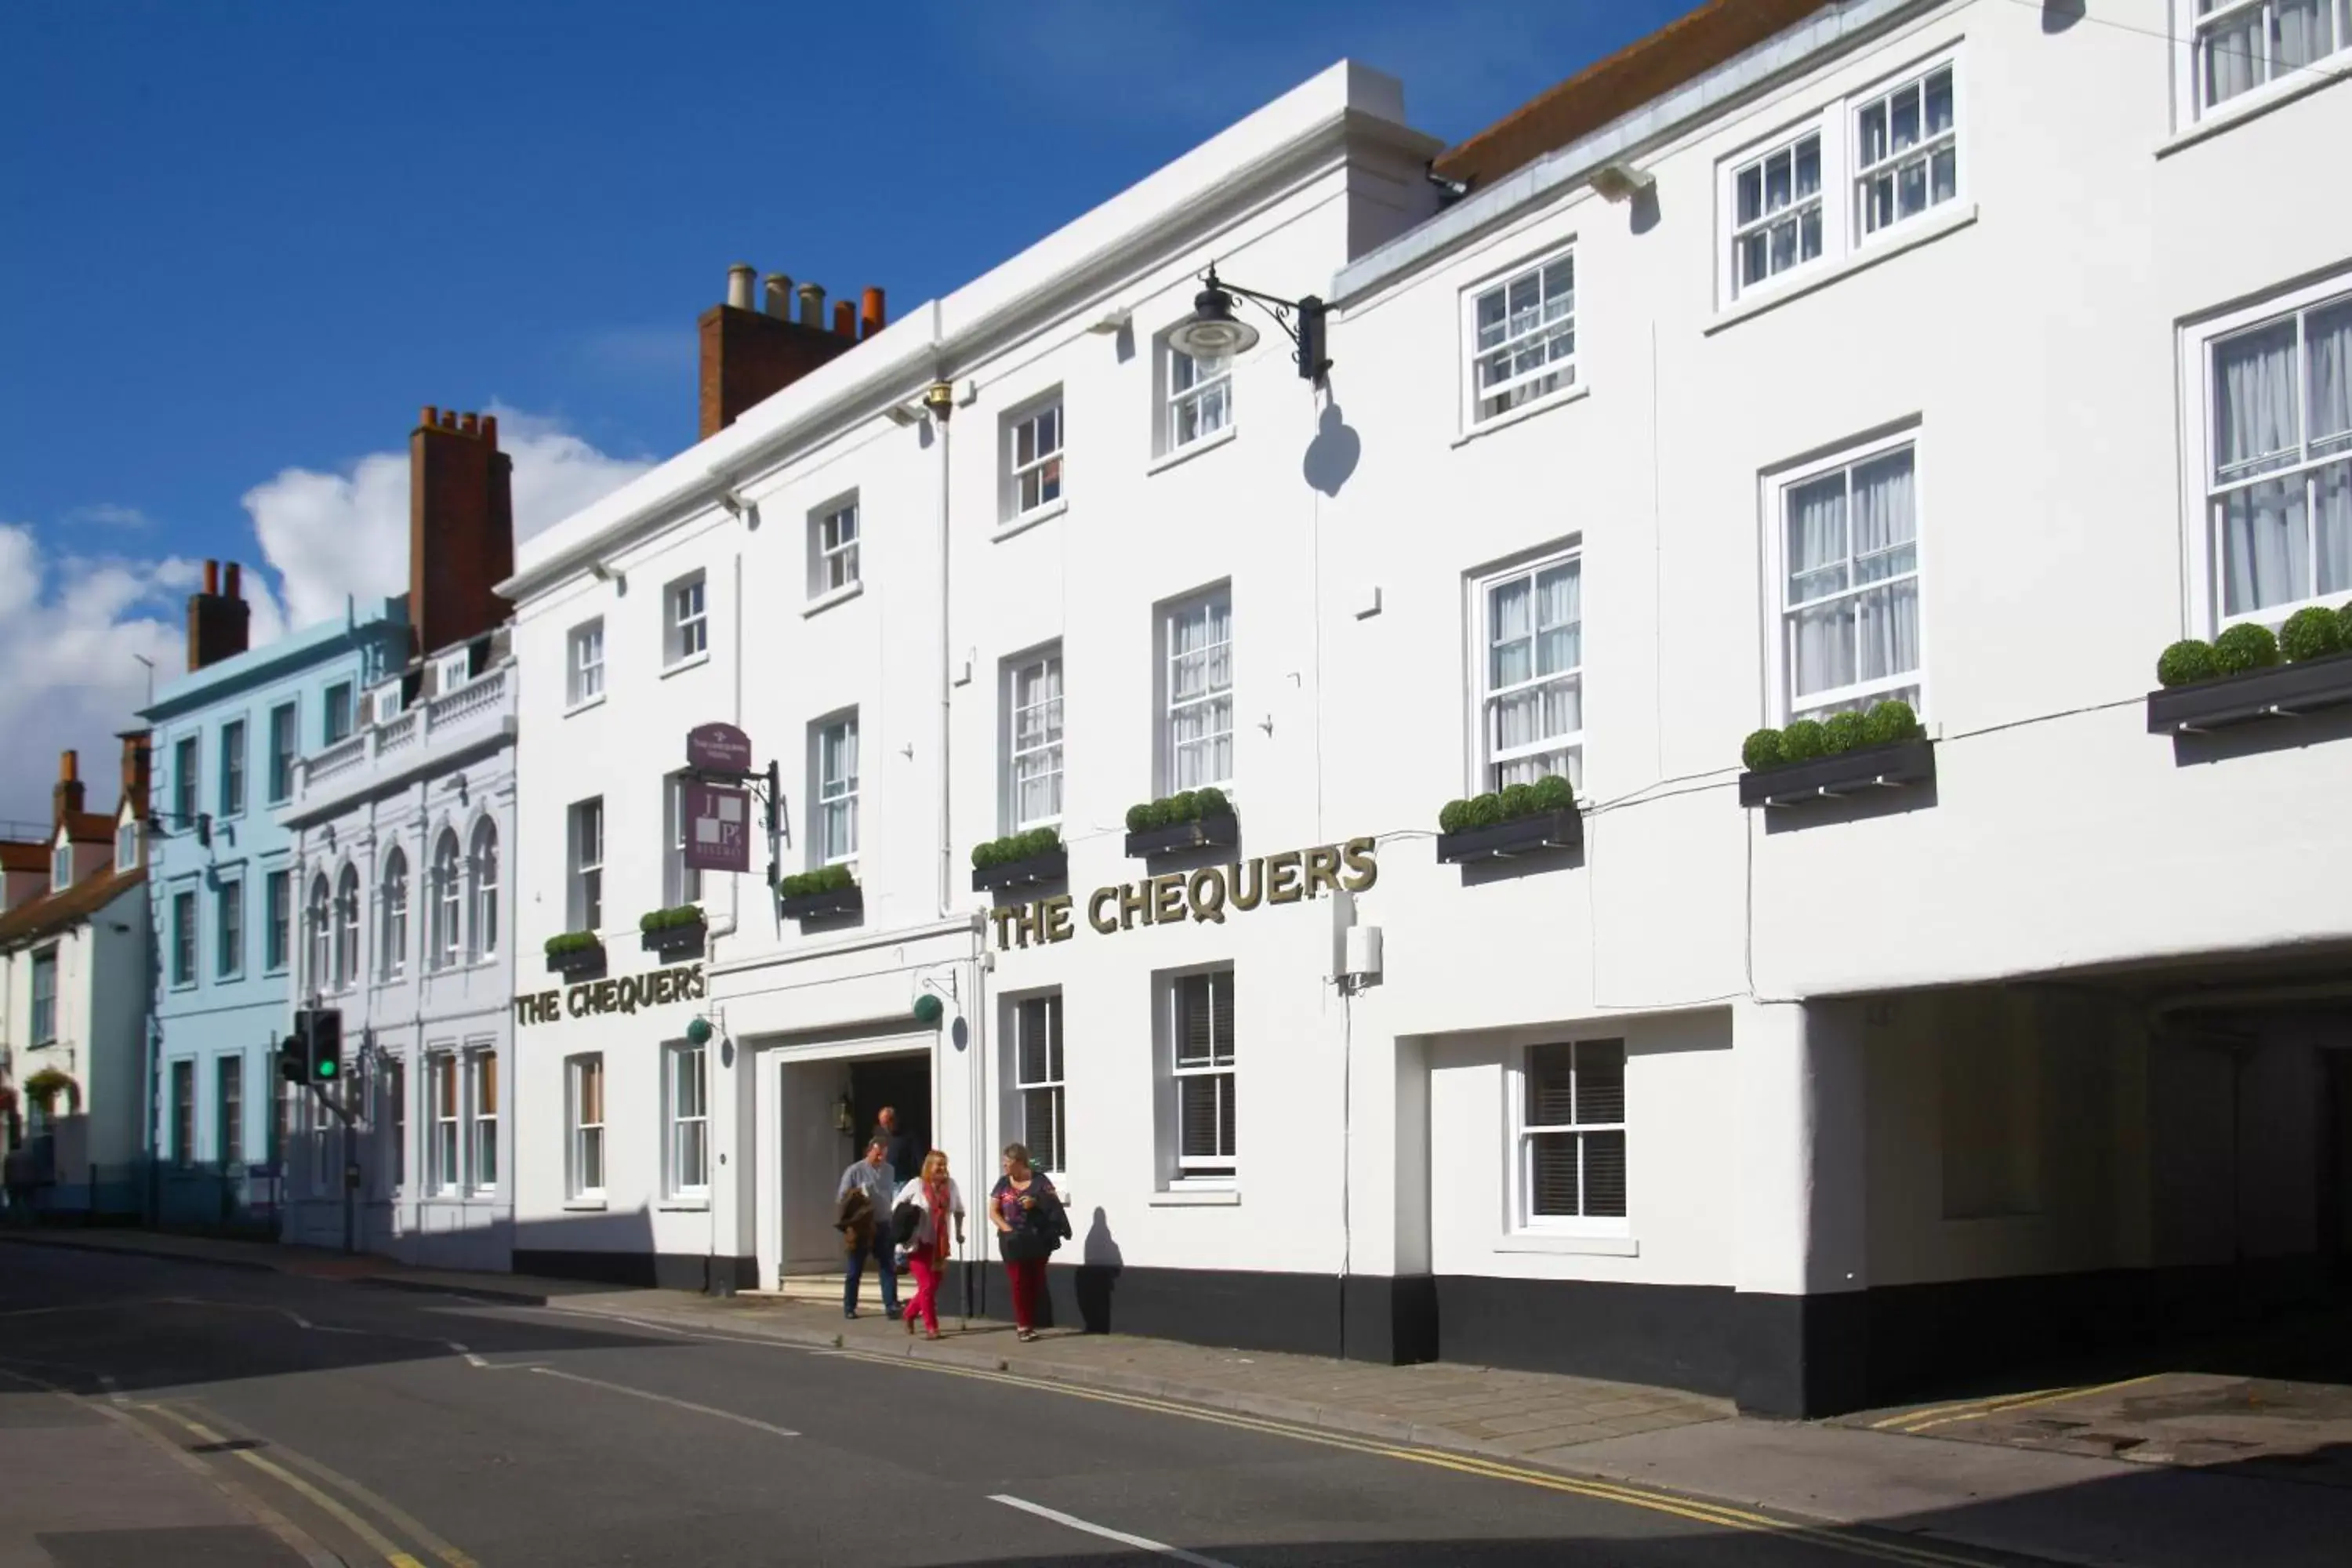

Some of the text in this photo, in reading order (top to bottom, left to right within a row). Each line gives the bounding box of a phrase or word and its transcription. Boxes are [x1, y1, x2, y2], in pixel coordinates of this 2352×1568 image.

[991, 837, 1377, 951] THE CHEQUERS
[516, 964, 705, 1026] THE CHEQUERS
